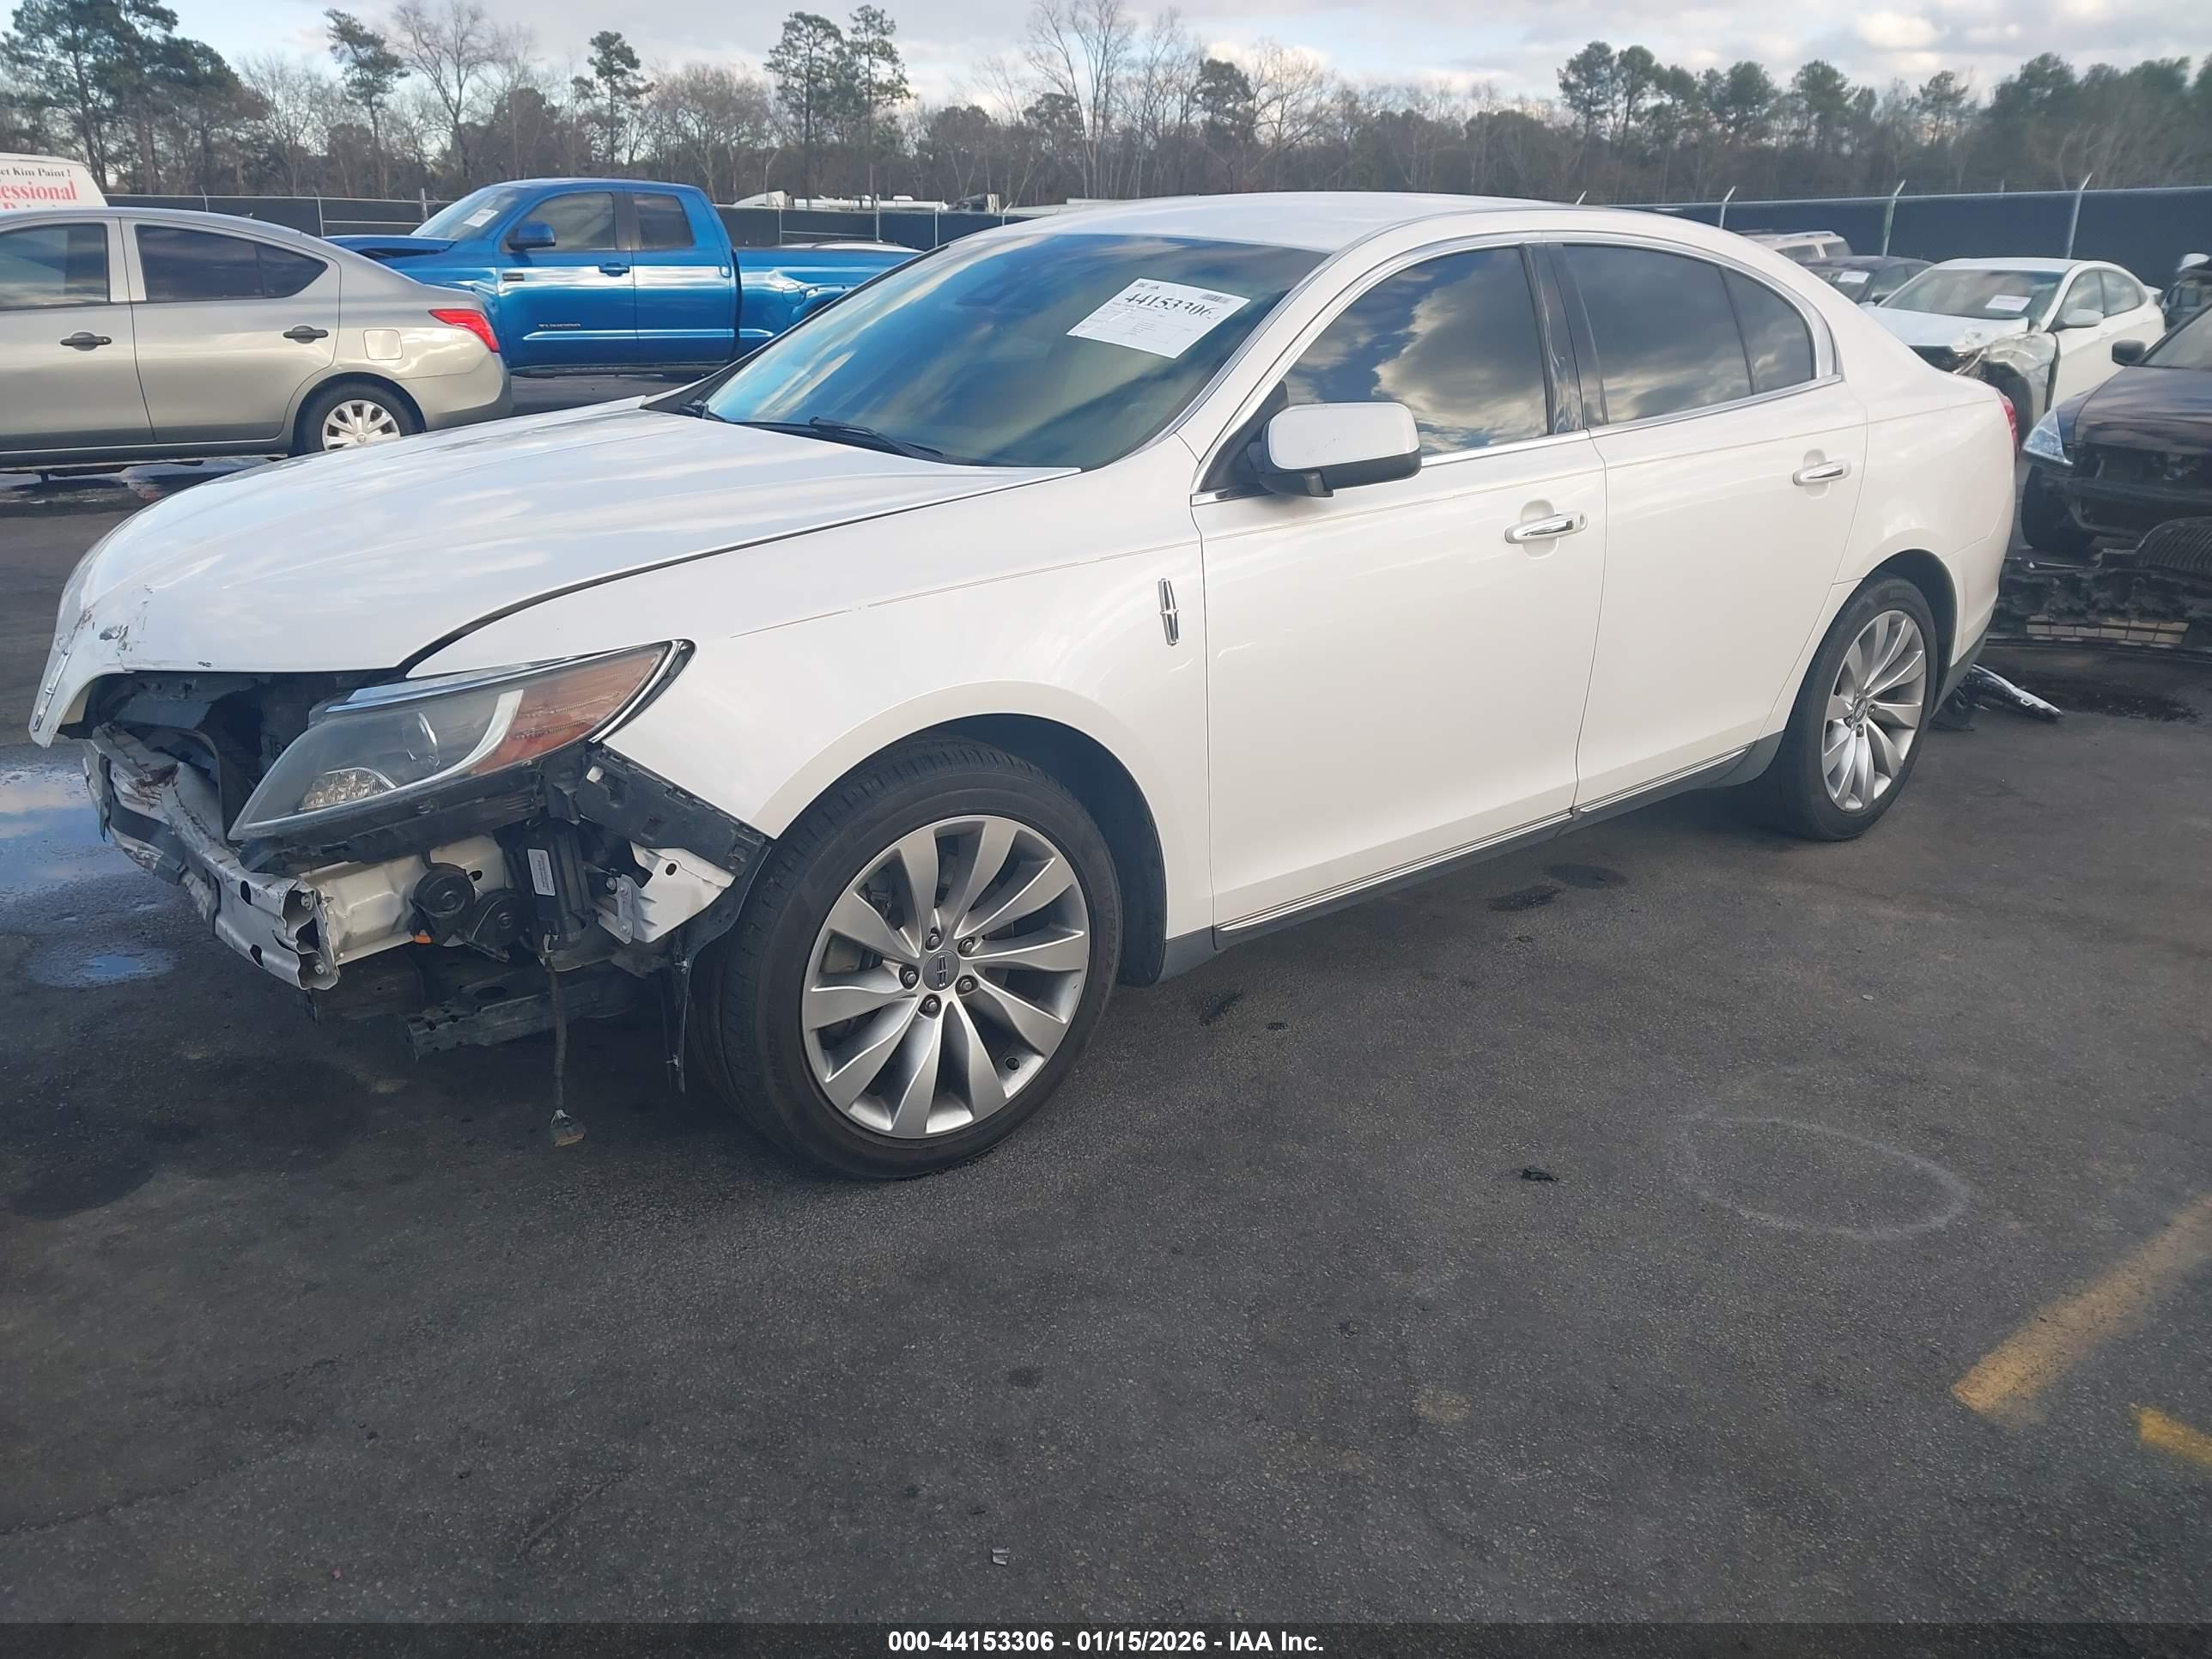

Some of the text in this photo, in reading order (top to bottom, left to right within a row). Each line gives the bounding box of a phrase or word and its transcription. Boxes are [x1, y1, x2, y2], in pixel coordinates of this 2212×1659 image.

[13, 167, 35, 176] Kim
[38, 167, 65, 177] Paint
[0, 179, 77, 200] essional
